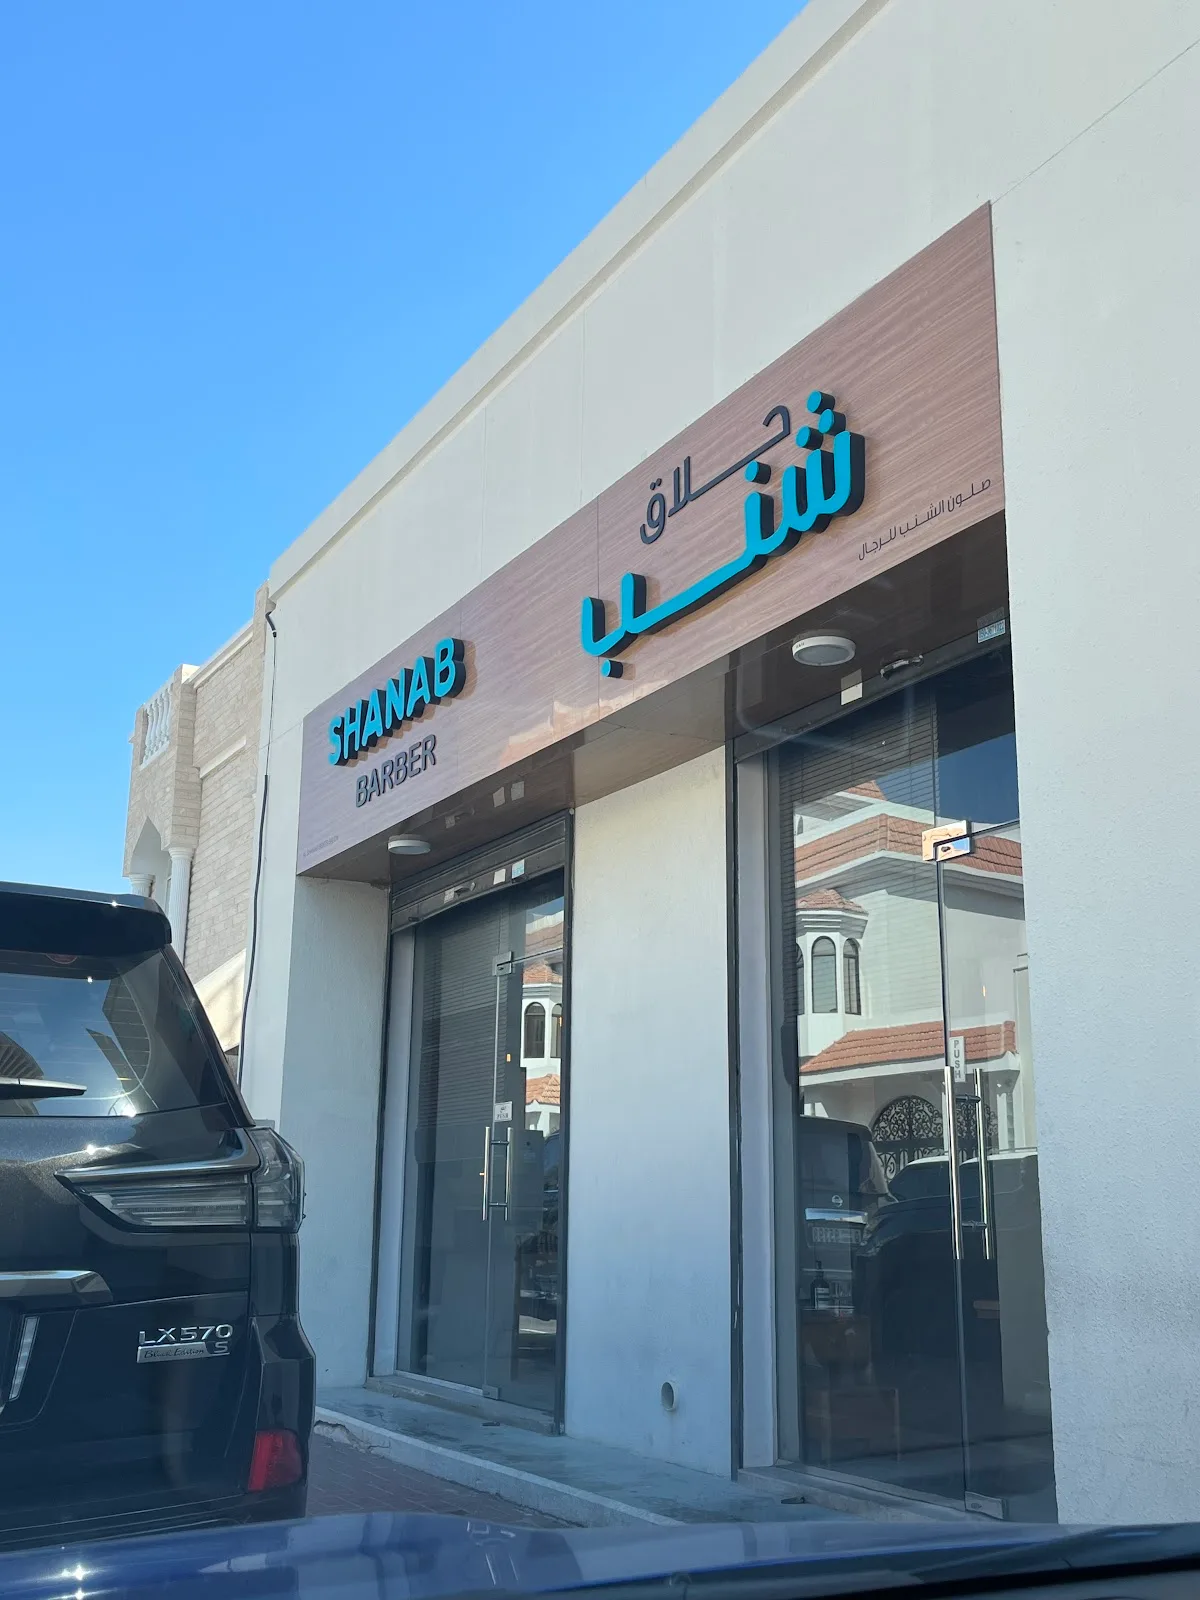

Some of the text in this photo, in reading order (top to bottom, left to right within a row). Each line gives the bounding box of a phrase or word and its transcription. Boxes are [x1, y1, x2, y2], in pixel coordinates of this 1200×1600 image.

[639, 405, 791, 545] حلاق
[858, 478, 991, 561] صلون الشنب للرجال
[581, 390, 866, 680] شنب
[327, 637, 466, 766] SHANAB
[355, 733, 437, 808] BARBER
[953, 1039, 962, 1079] PUSH
